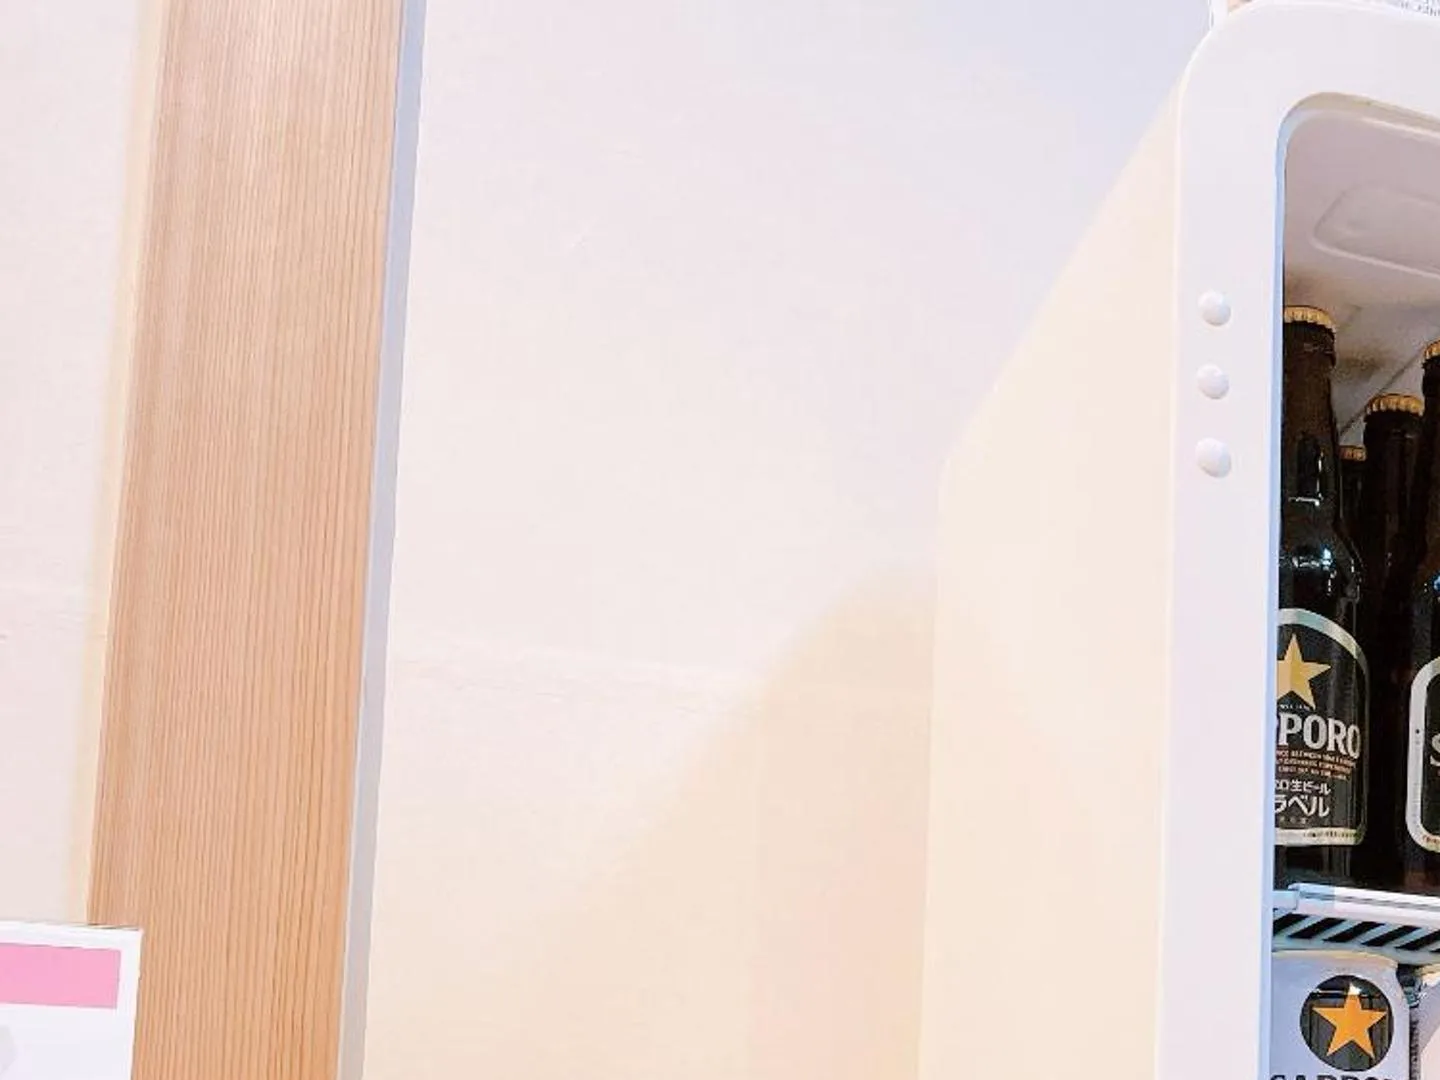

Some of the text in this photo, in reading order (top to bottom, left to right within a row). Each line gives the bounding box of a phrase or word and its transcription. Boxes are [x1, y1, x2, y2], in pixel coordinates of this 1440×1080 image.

[1277, 713, 1360, 760] PORO
[1275, 794, 1329, 818] ラベル
